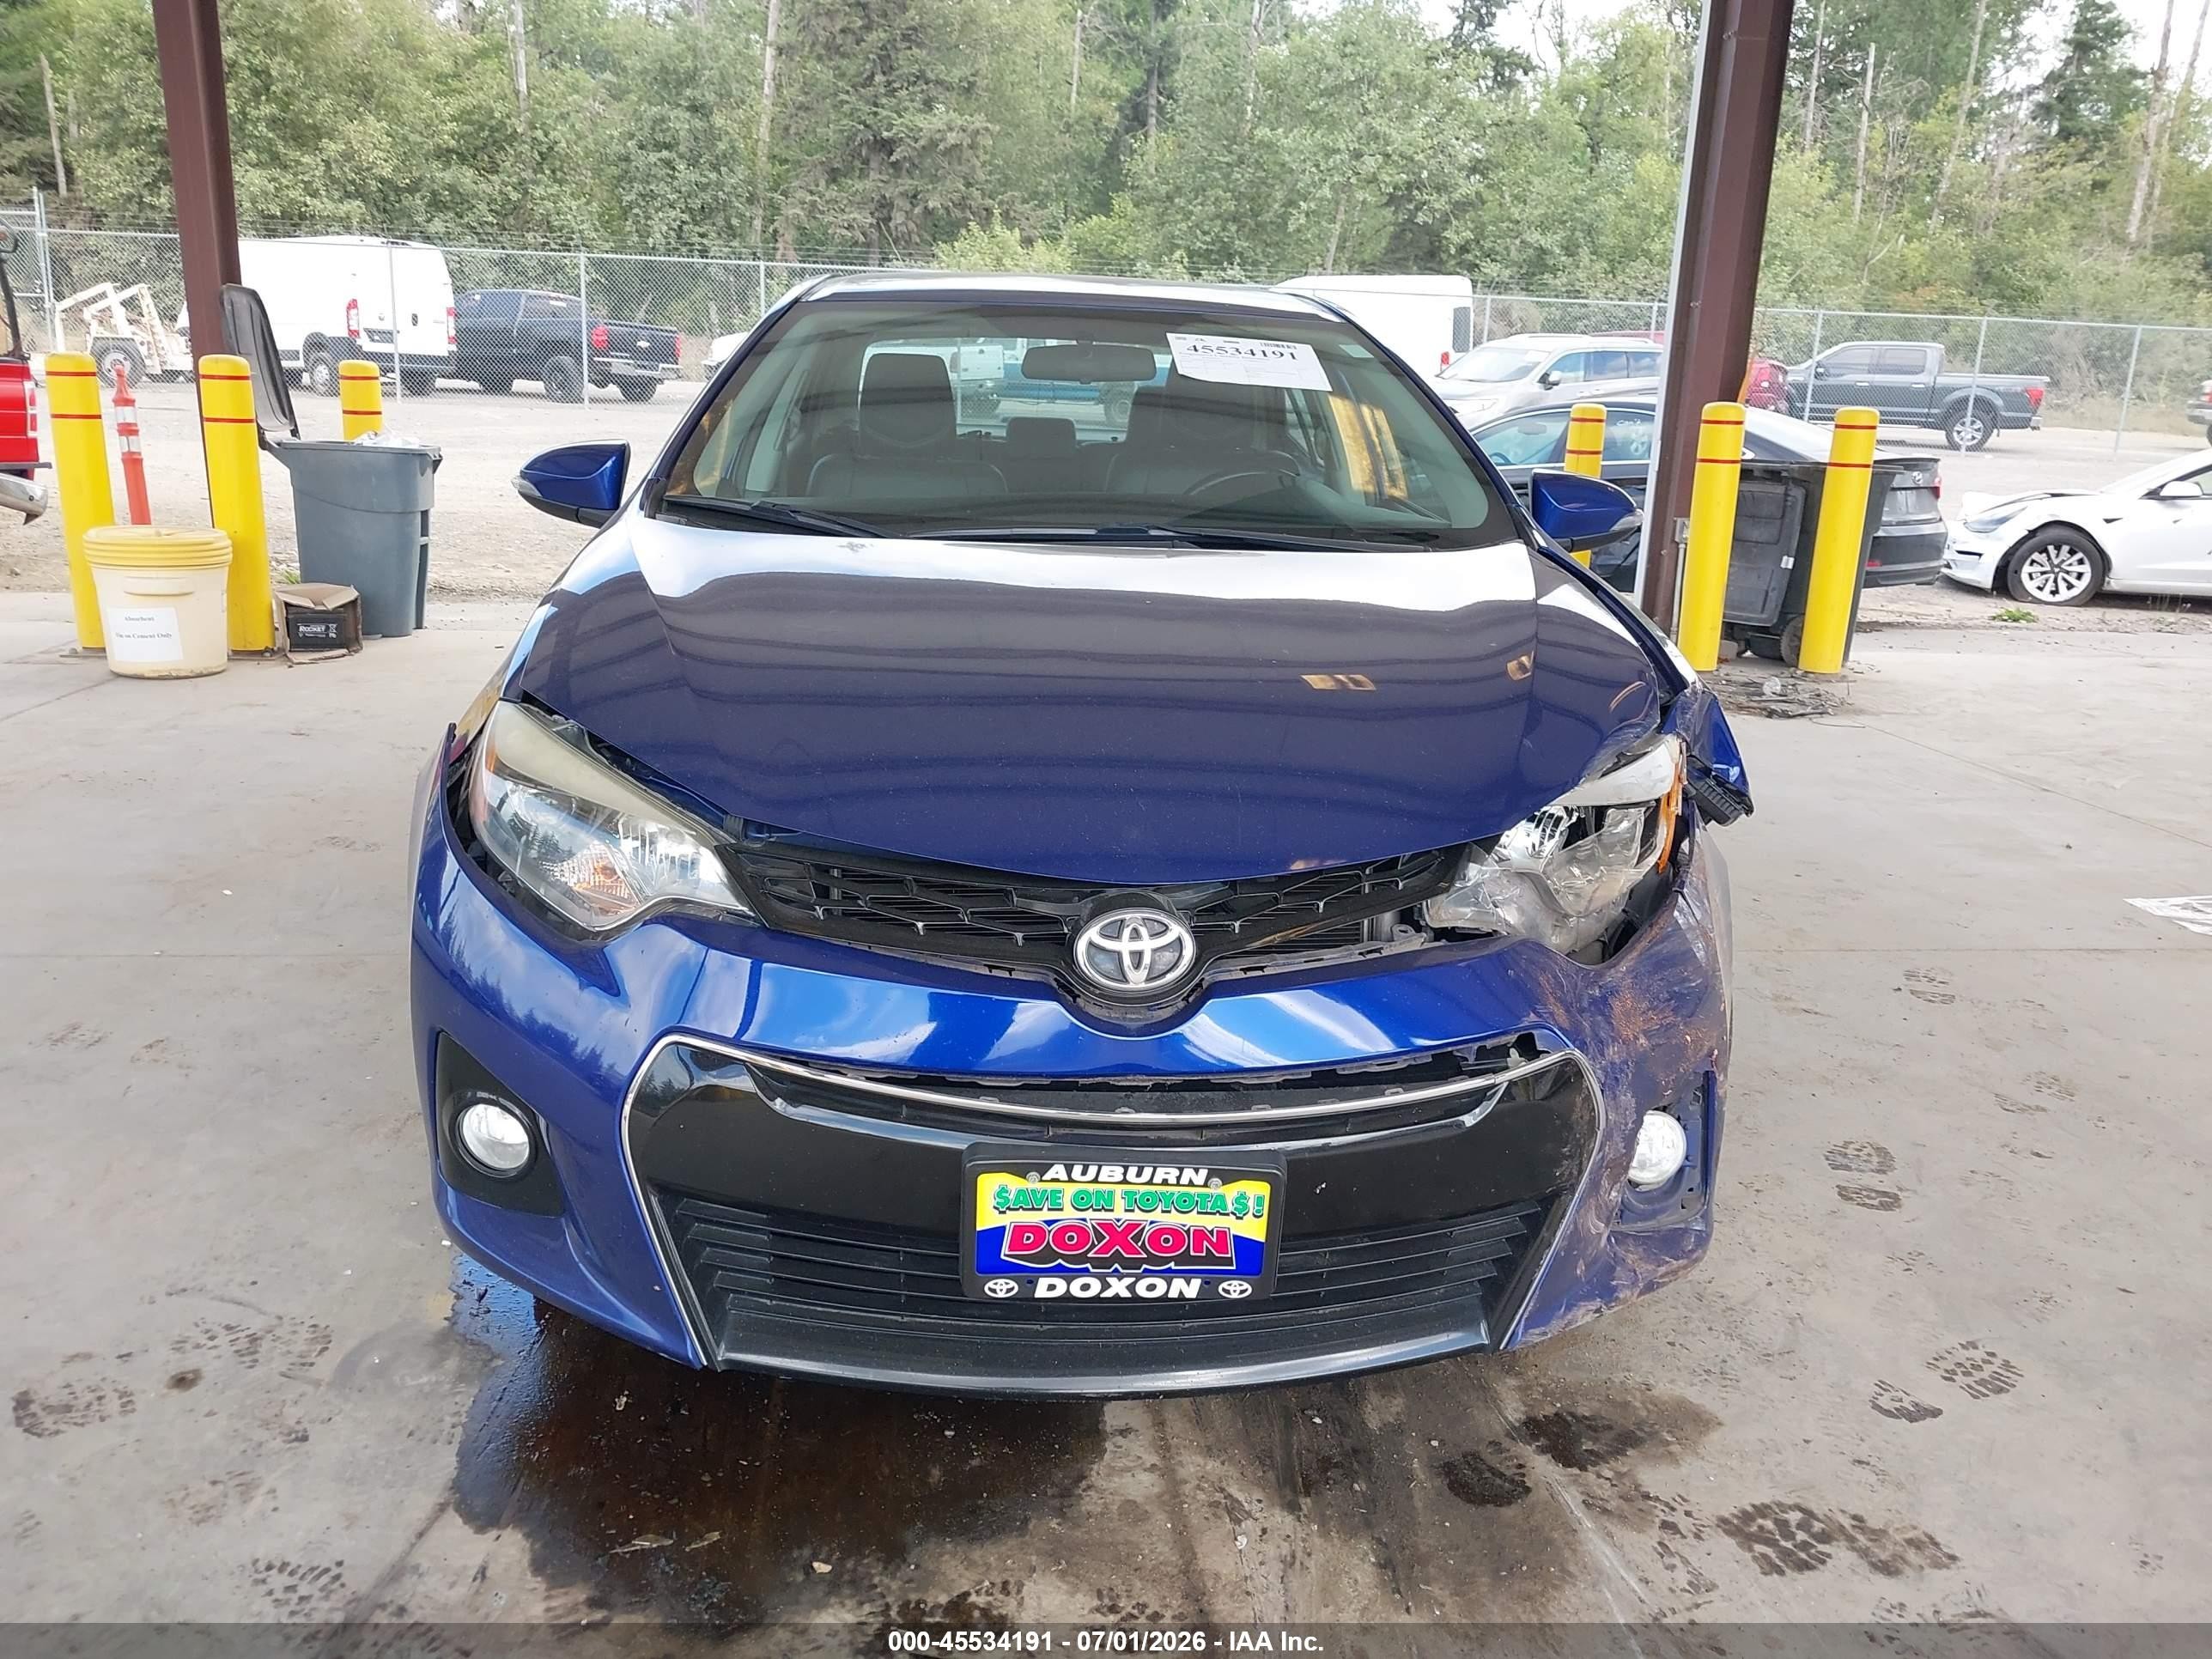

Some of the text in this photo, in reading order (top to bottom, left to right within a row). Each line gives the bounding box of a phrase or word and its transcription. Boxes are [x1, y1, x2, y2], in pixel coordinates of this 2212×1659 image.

[1187, 344, 1298, 361] 45534191
[1042, 1164, 1208, 1186] AUBURN
[993, 1185, 1063, 1214] $AVE
[1070, 1188, 1115, 1212] ON
[1004, 1218, 1234, 1259] DOXON
[1033, 1276, 1202, 1299] DOXON
